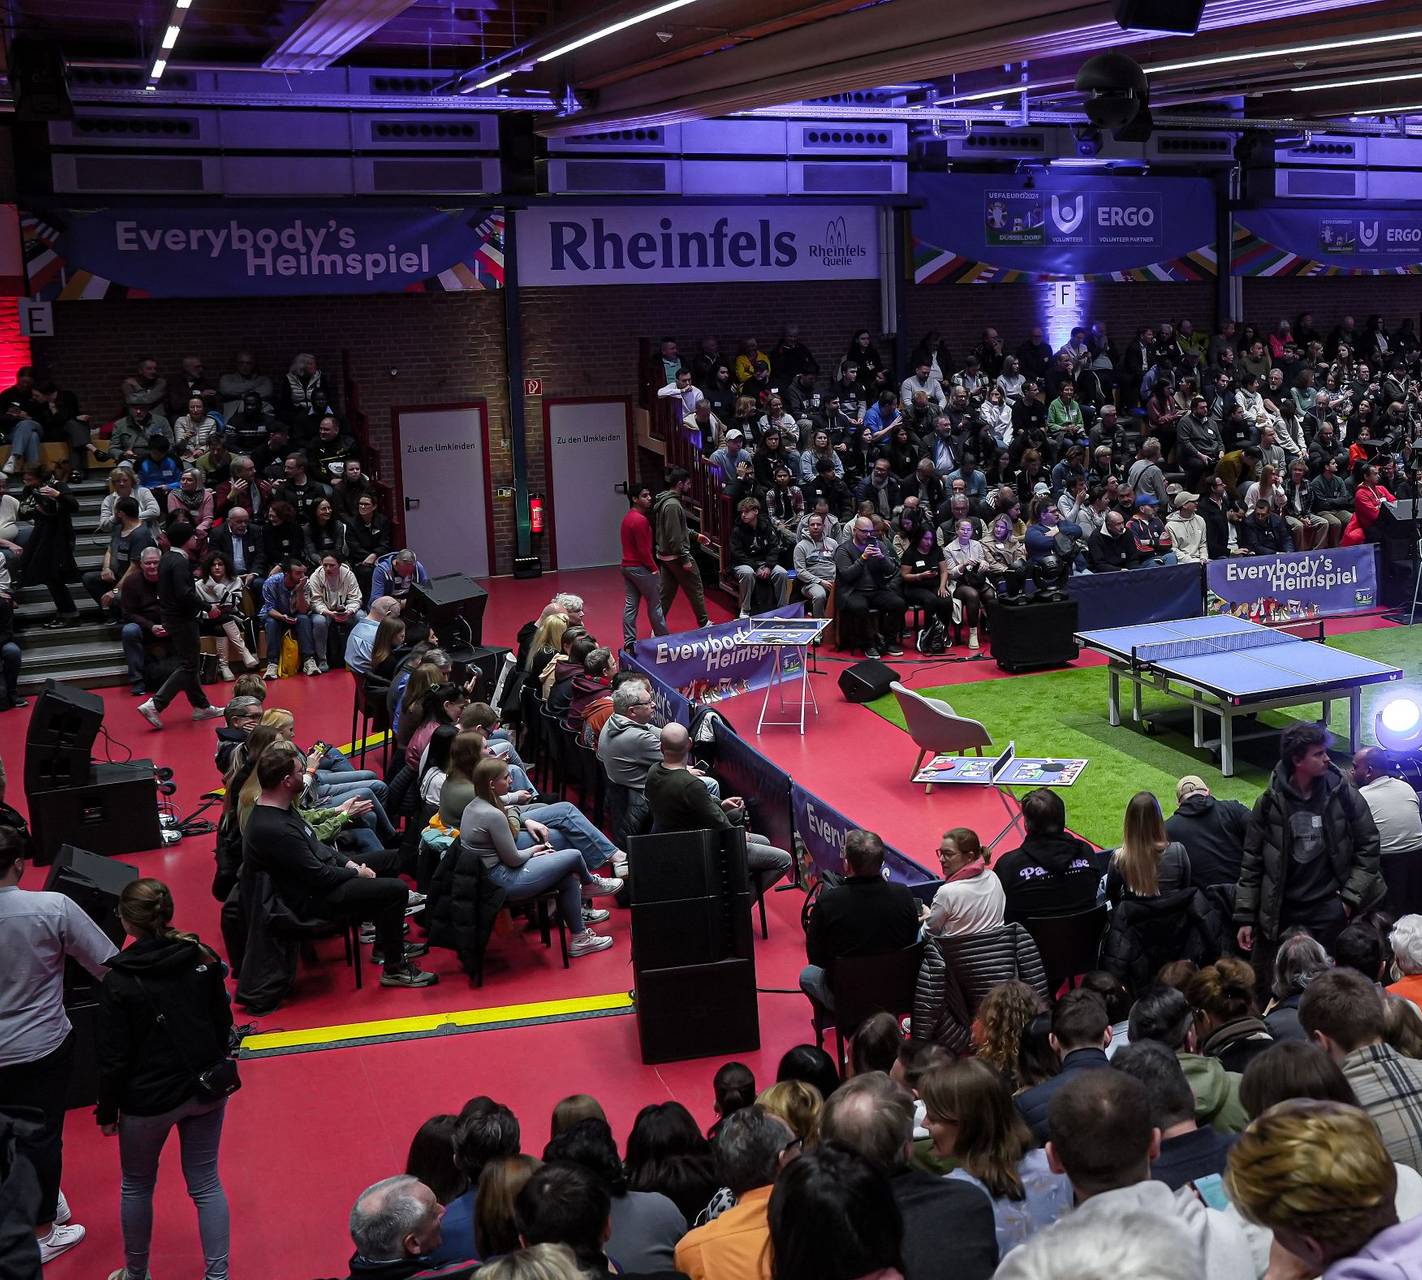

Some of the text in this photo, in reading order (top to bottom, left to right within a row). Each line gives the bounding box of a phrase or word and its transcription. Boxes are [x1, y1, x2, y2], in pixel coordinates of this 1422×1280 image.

[1097, 206, 1154, 226] ERGO
[548, 217, 798, 271] Rheinfels
[1386, 228, 1422, 242] ERGO
[808, 244, 867, 259] Rheinfels
[822, 256, 853, 267] Quelle
[246, 244, 430, 281] Heimspiel
[1061, 284, 1069, 305] F
[28, 307, 47, 334] E
[407, 442, 476, 454] Zu den Umkleiden
[557, 434, 621, 445] Zu den Umkleiden
[1272, 566, 1358, 592] Heimspiel
[655, 626, 750, 665] Everybod
[706, 642, 777, 672] Heimspi
[1019, 858, 1090, 880] Paise
